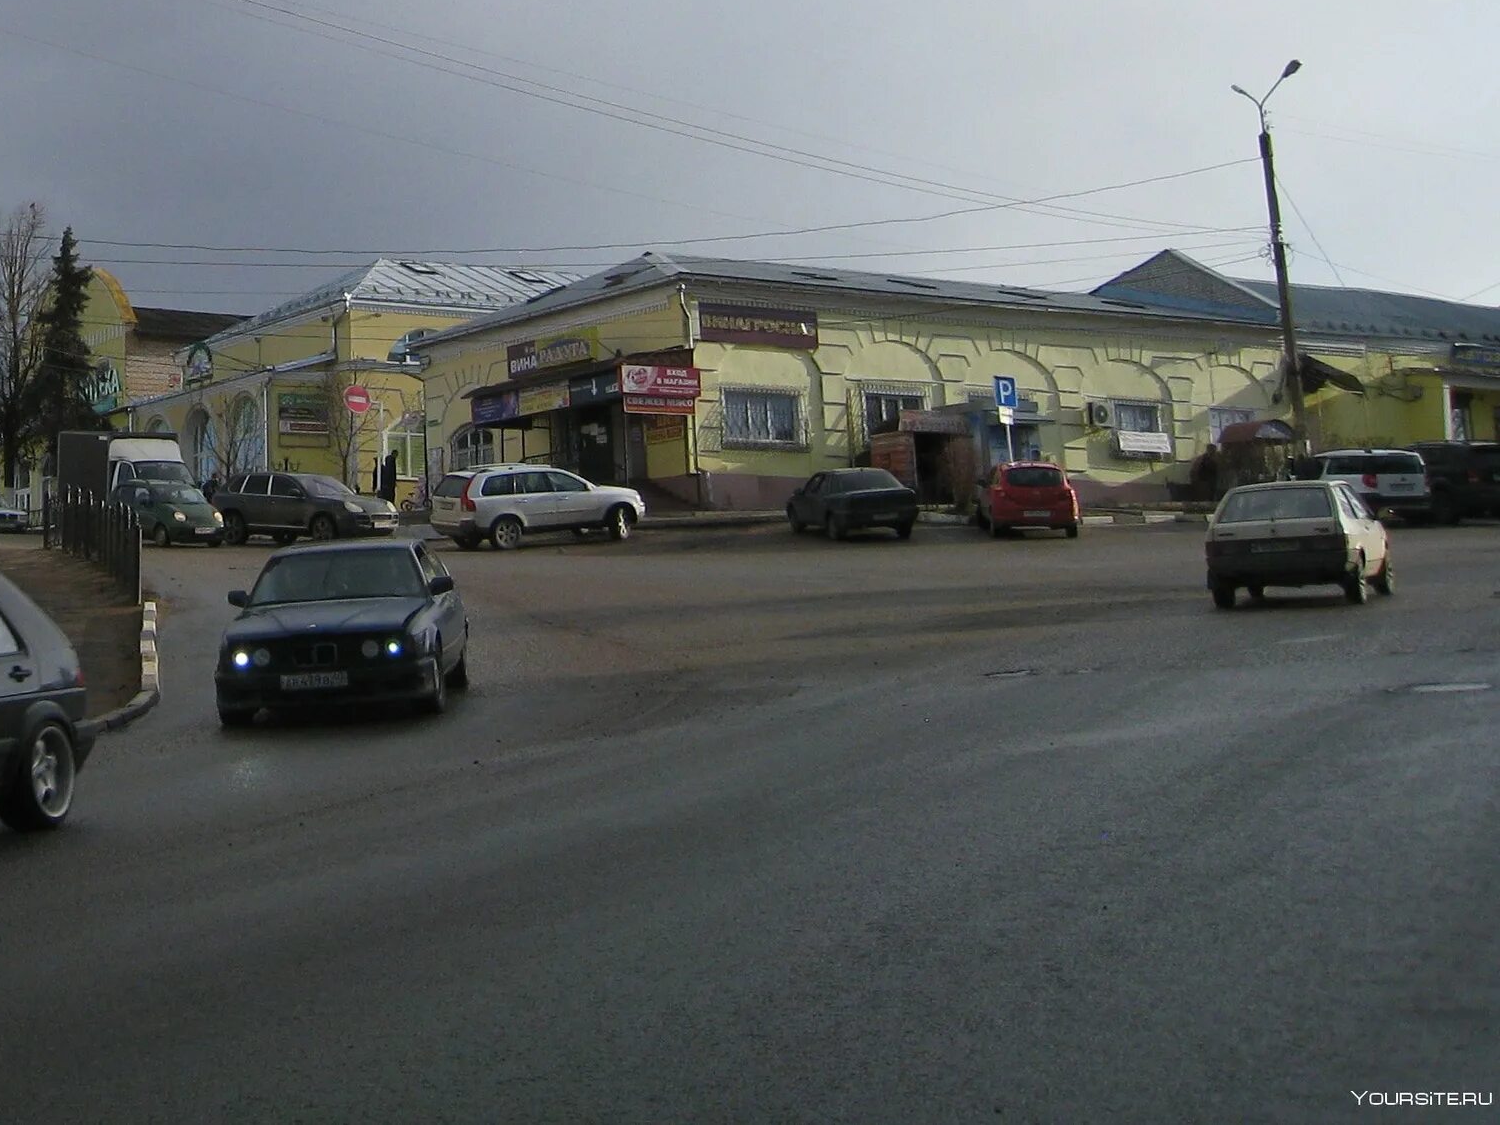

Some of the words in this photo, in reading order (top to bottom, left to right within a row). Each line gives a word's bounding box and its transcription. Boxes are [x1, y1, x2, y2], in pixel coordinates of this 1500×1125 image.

[510, 354, 537, 374] ВИНА
[666, 368, 687, 377] ВХОД
[663, 377, 698, 387] МАГАЗИН
[999, 379, 1012, 404] P
